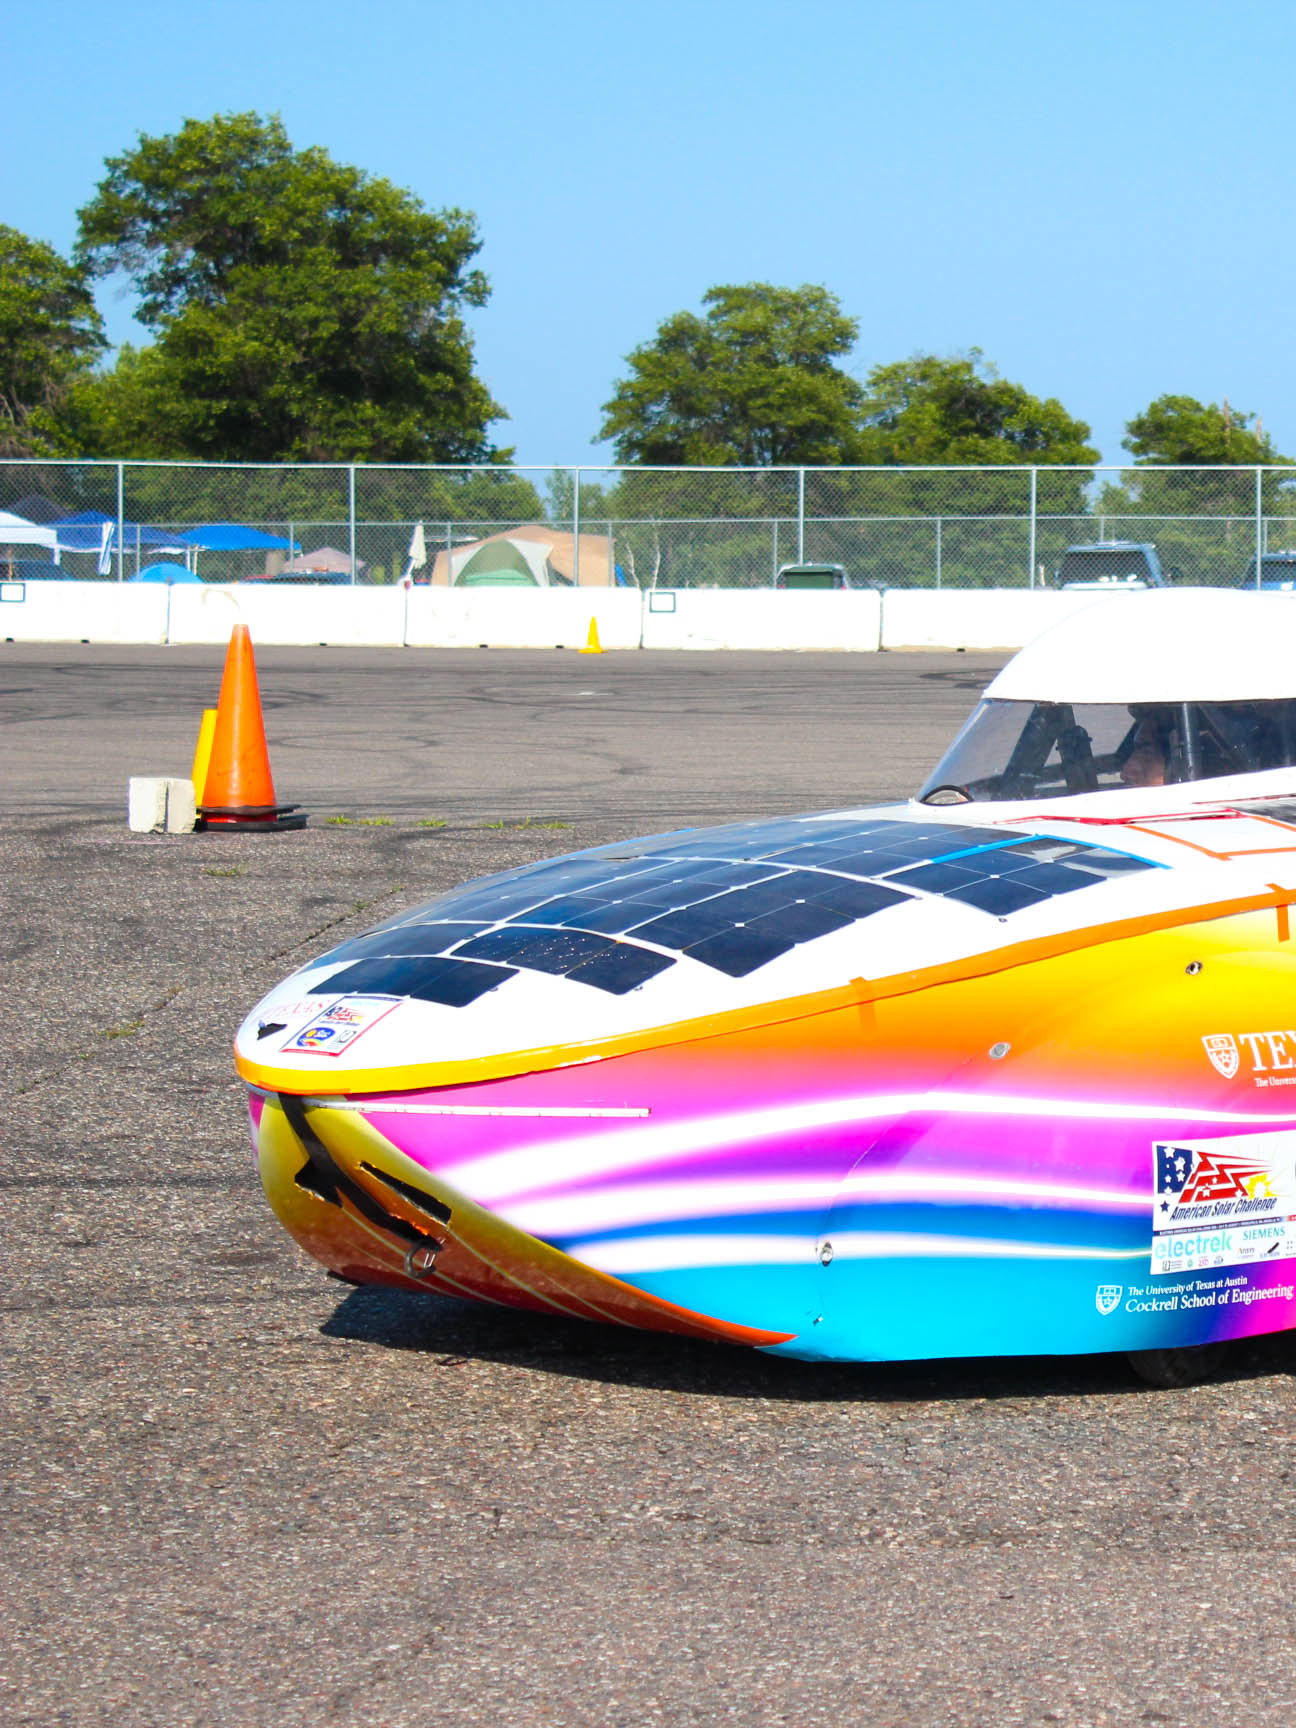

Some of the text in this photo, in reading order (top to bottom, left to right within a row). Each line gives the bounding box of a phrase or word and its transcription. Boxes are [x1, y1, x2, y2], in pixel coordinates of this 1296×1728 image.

[1255, 1077, 1268, 1088] The
[1170, 1204, 1212, 1221] American
[1212, 1201, 1236, 1217] Solar
[1235, 1198, 1278, 1214] Challenge
[1242, 1225, 1286, 1241] SIEMENS
[1155, 1231, 1233, 1259] electrek
[1128, 1275, 1248, 1296] The University of Texas at Austin
[1125, 1284, 1294, 1313] Cockrell School of Engineering
